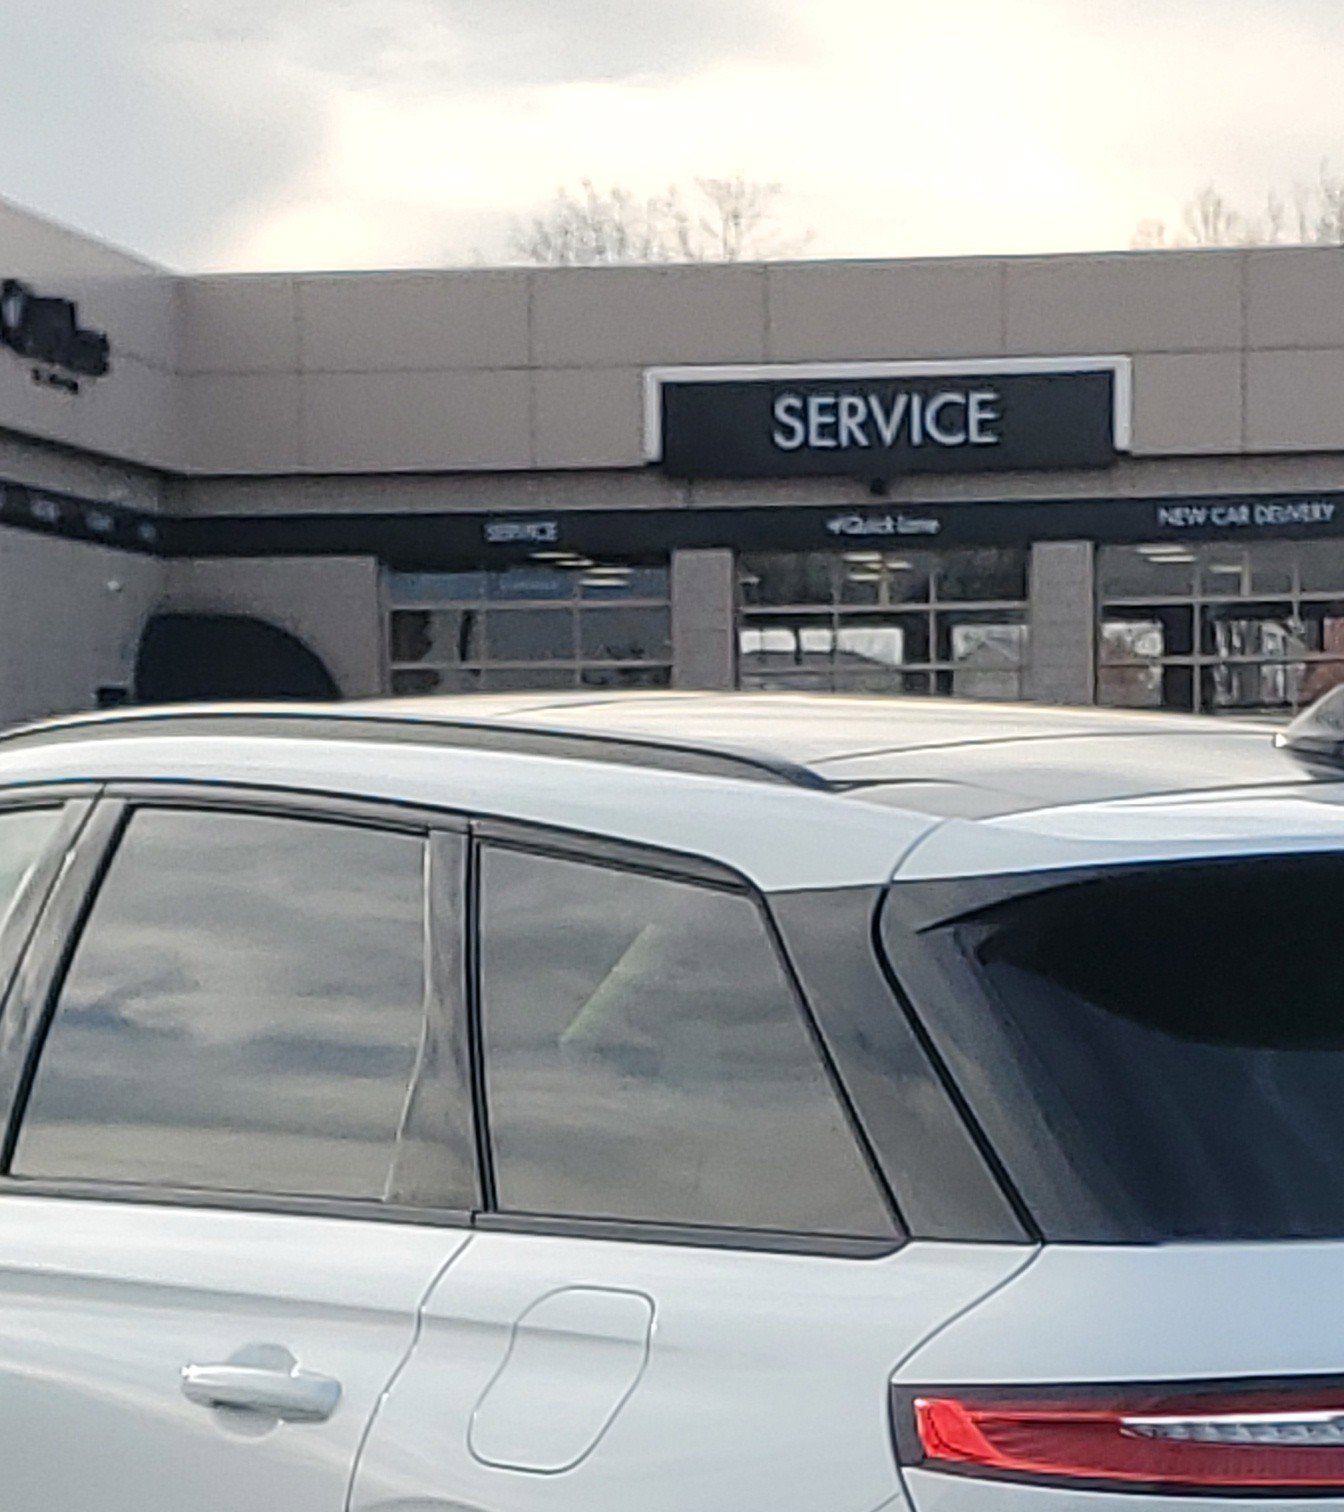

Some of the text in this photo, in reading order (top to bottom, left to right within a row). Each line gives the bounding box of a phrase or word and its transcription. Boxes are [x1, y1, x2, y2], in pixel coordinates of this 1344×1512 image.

[772, 391, 1000, 450] SERVICE
[1157, 502, 1335, 527] NEW CAR DELIVERY
[485, 521, 558, 543] SERVICE
